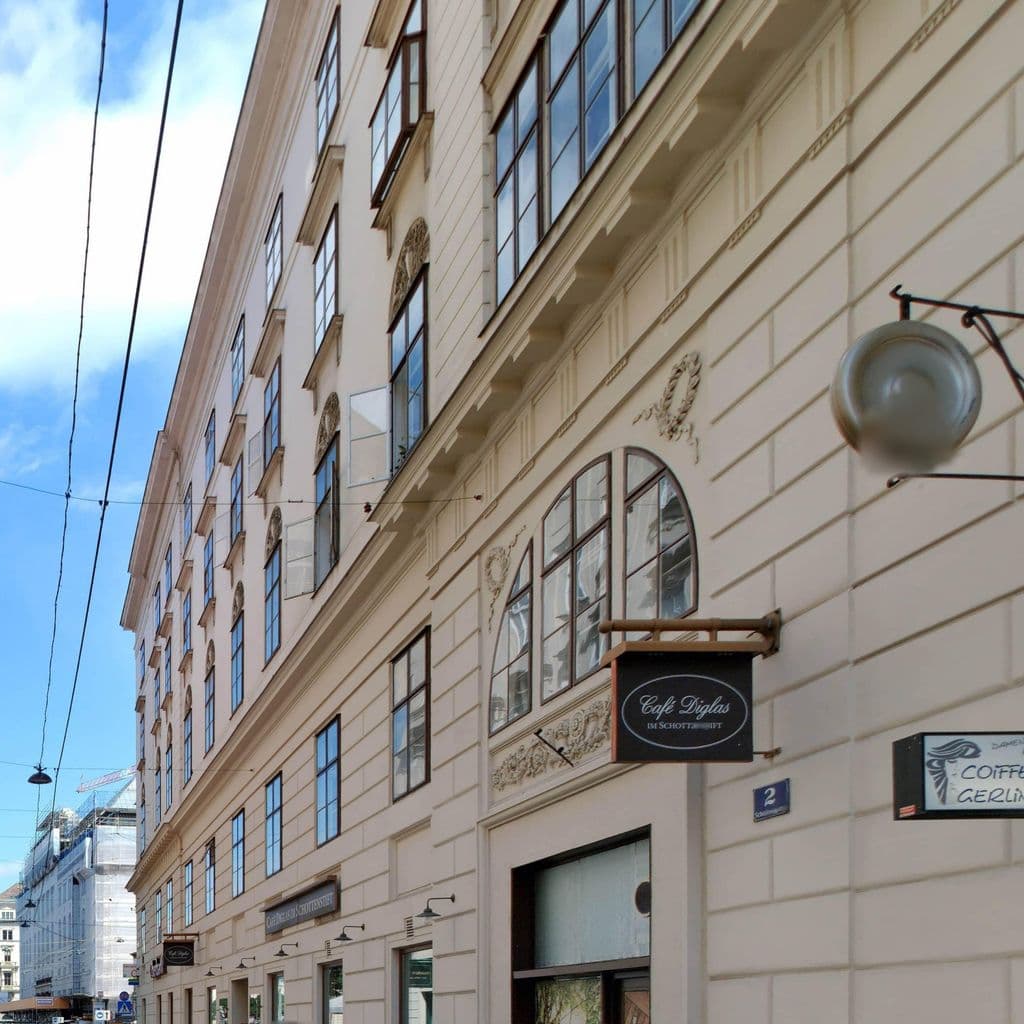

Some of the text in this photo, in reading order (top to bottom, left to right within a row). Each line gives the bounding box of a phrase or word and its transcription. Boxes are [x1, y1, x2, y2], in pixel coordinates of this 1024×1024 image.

[640, 695, 730, 721] Café Diglas
[764, 787, 776, 808] 2
